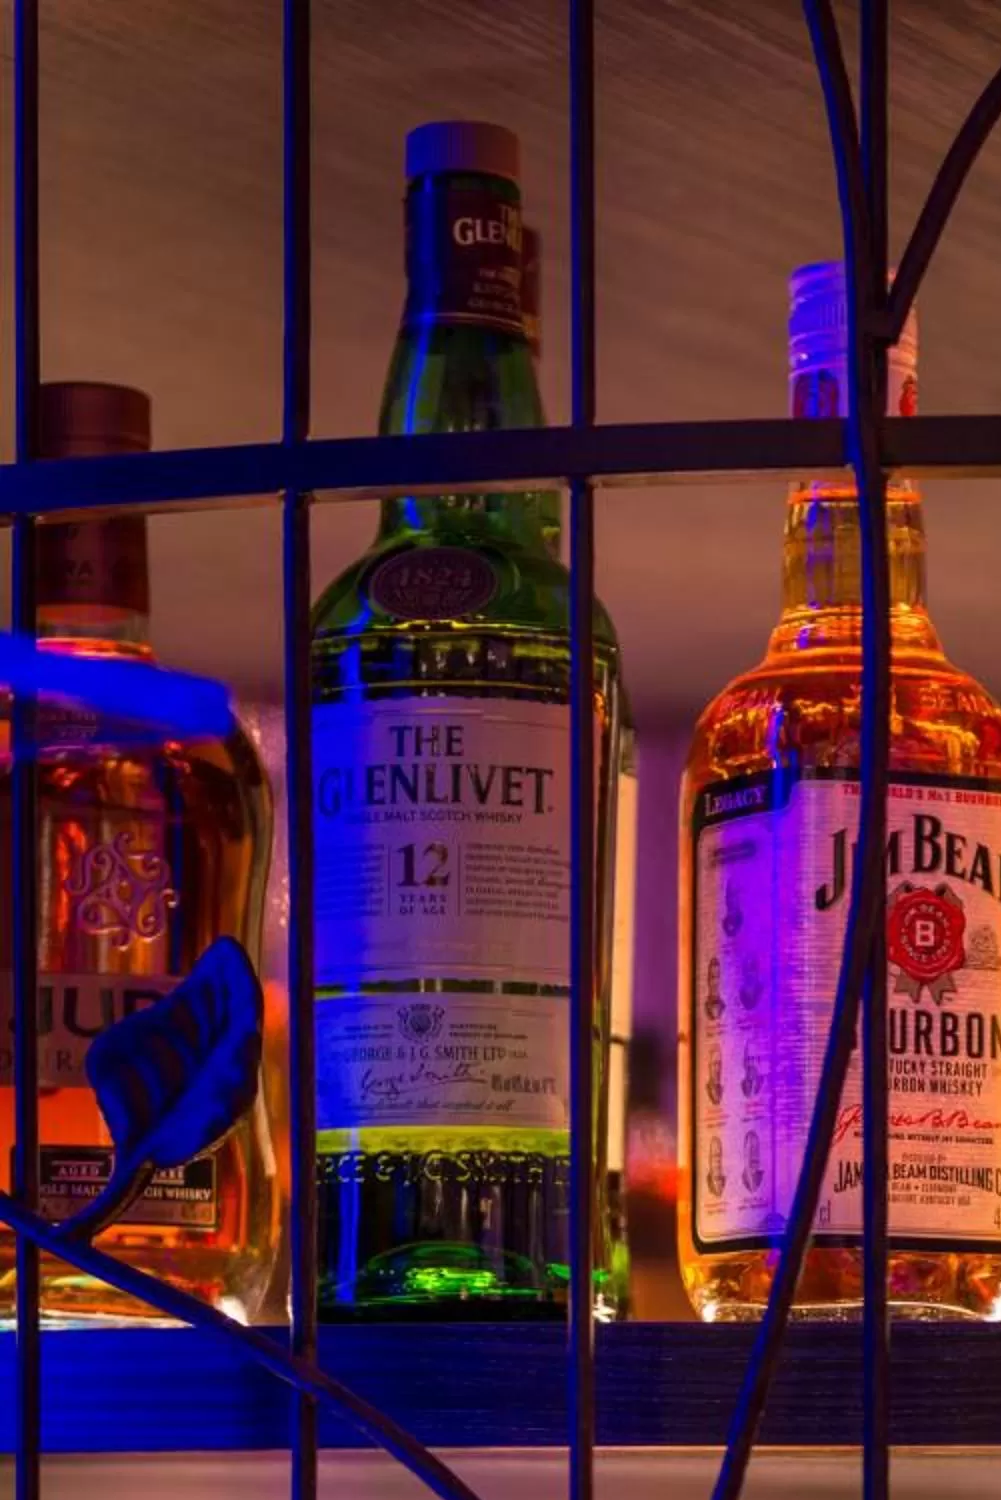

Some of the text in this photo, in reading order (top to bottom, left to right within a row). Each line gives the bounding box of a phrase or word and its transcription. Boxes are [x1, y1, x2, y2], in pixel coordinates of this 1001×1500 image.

[389, 725, 464, 757] THE
[318, 763, 554, 817] GLENLIVET
[397, 843, 449, 888] 12
[915, 920, 935, 947] B
[888, 1059, 988, 1079] TUCKY STRAIGHT
[929, 1076, 983, 1096] WHISKEY
[58, 1165, 101, 1177] AGED
[892, 1162, 928, 1181] BEAM
[929, 1167, 994, 1193] DISTILLING
